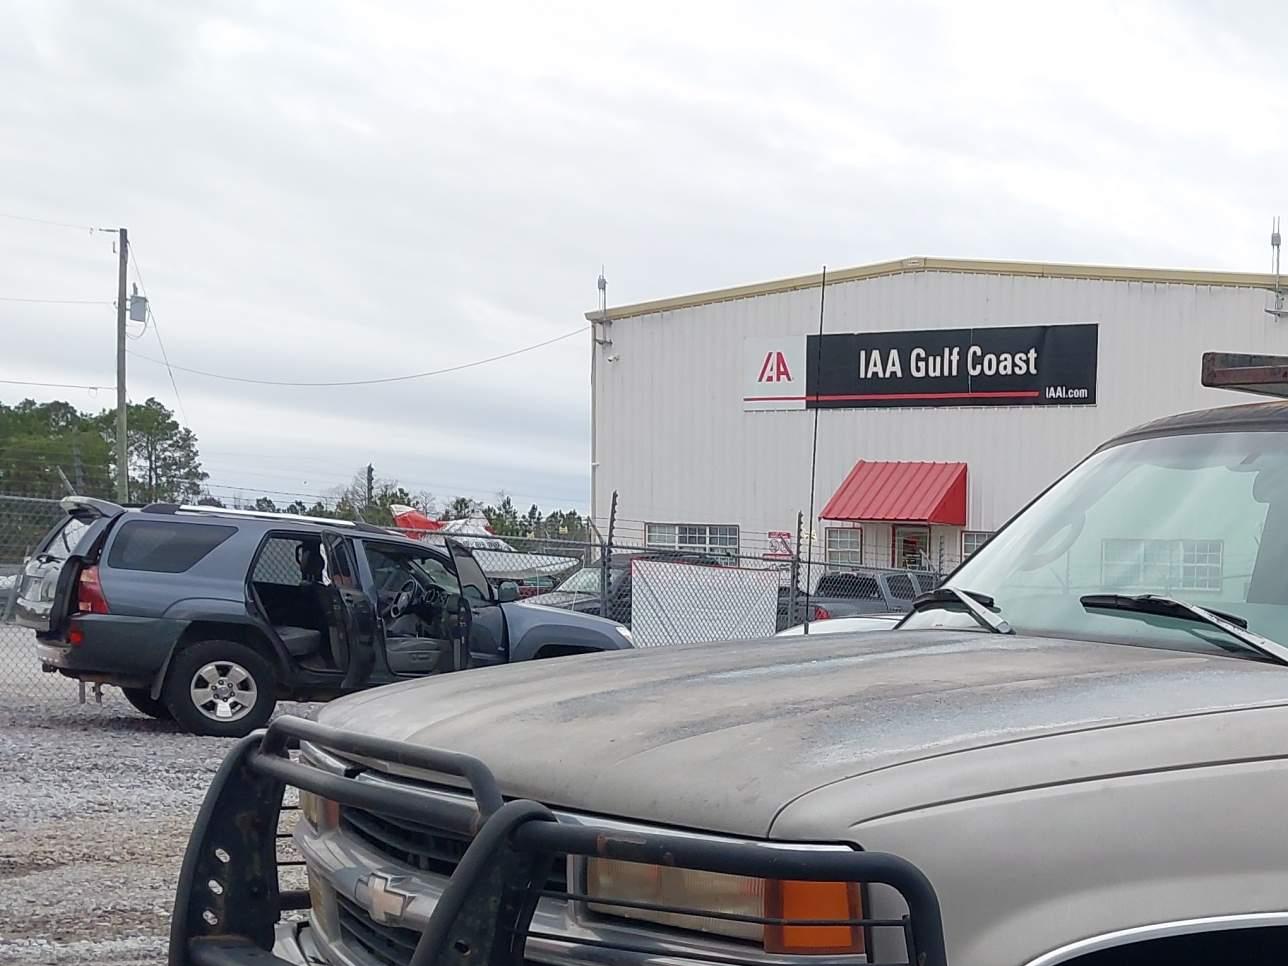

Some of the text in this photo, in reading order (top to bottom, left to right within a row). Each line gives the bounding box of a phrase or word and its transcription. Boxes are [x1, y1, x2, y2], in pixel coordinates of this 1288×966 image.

[859, 345, 1038, 379] IAA Gulf Coast
